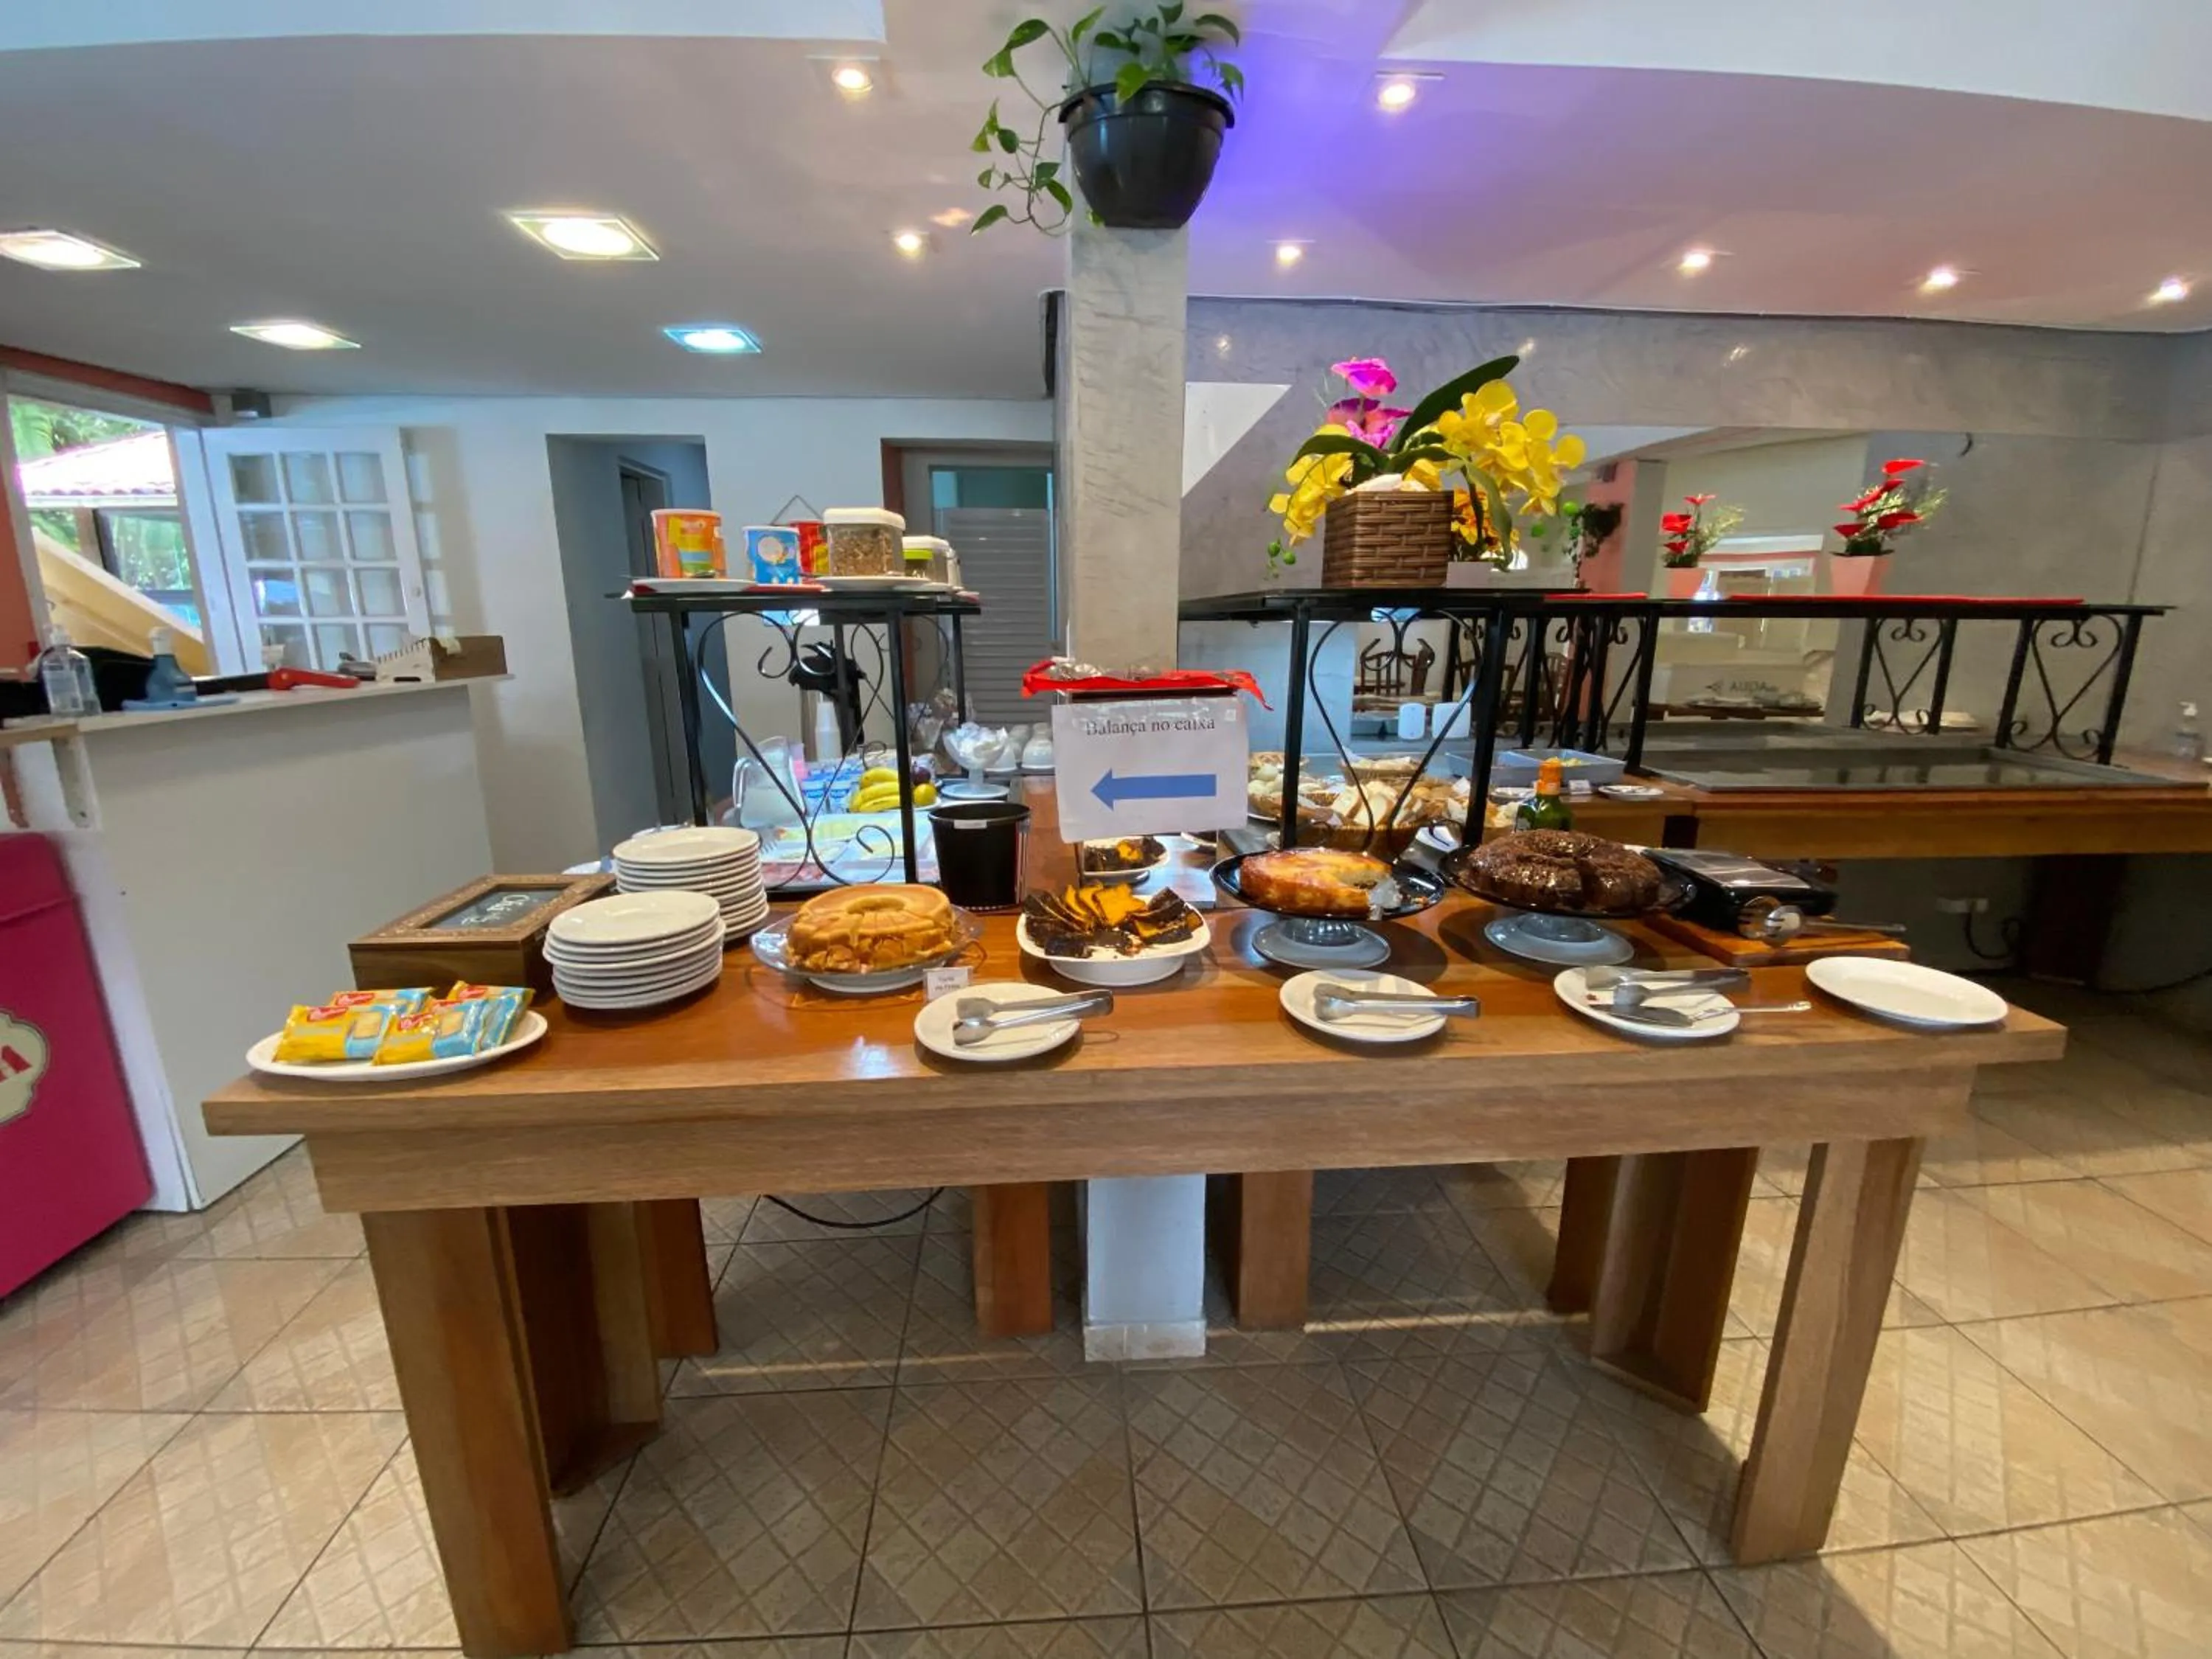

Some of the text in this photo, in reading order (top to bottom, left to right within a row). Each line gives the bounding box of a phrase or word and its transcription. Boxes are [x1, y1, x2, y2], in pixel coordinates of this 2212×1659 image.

[1086, 717, 1216, 737] Balança no caixa
